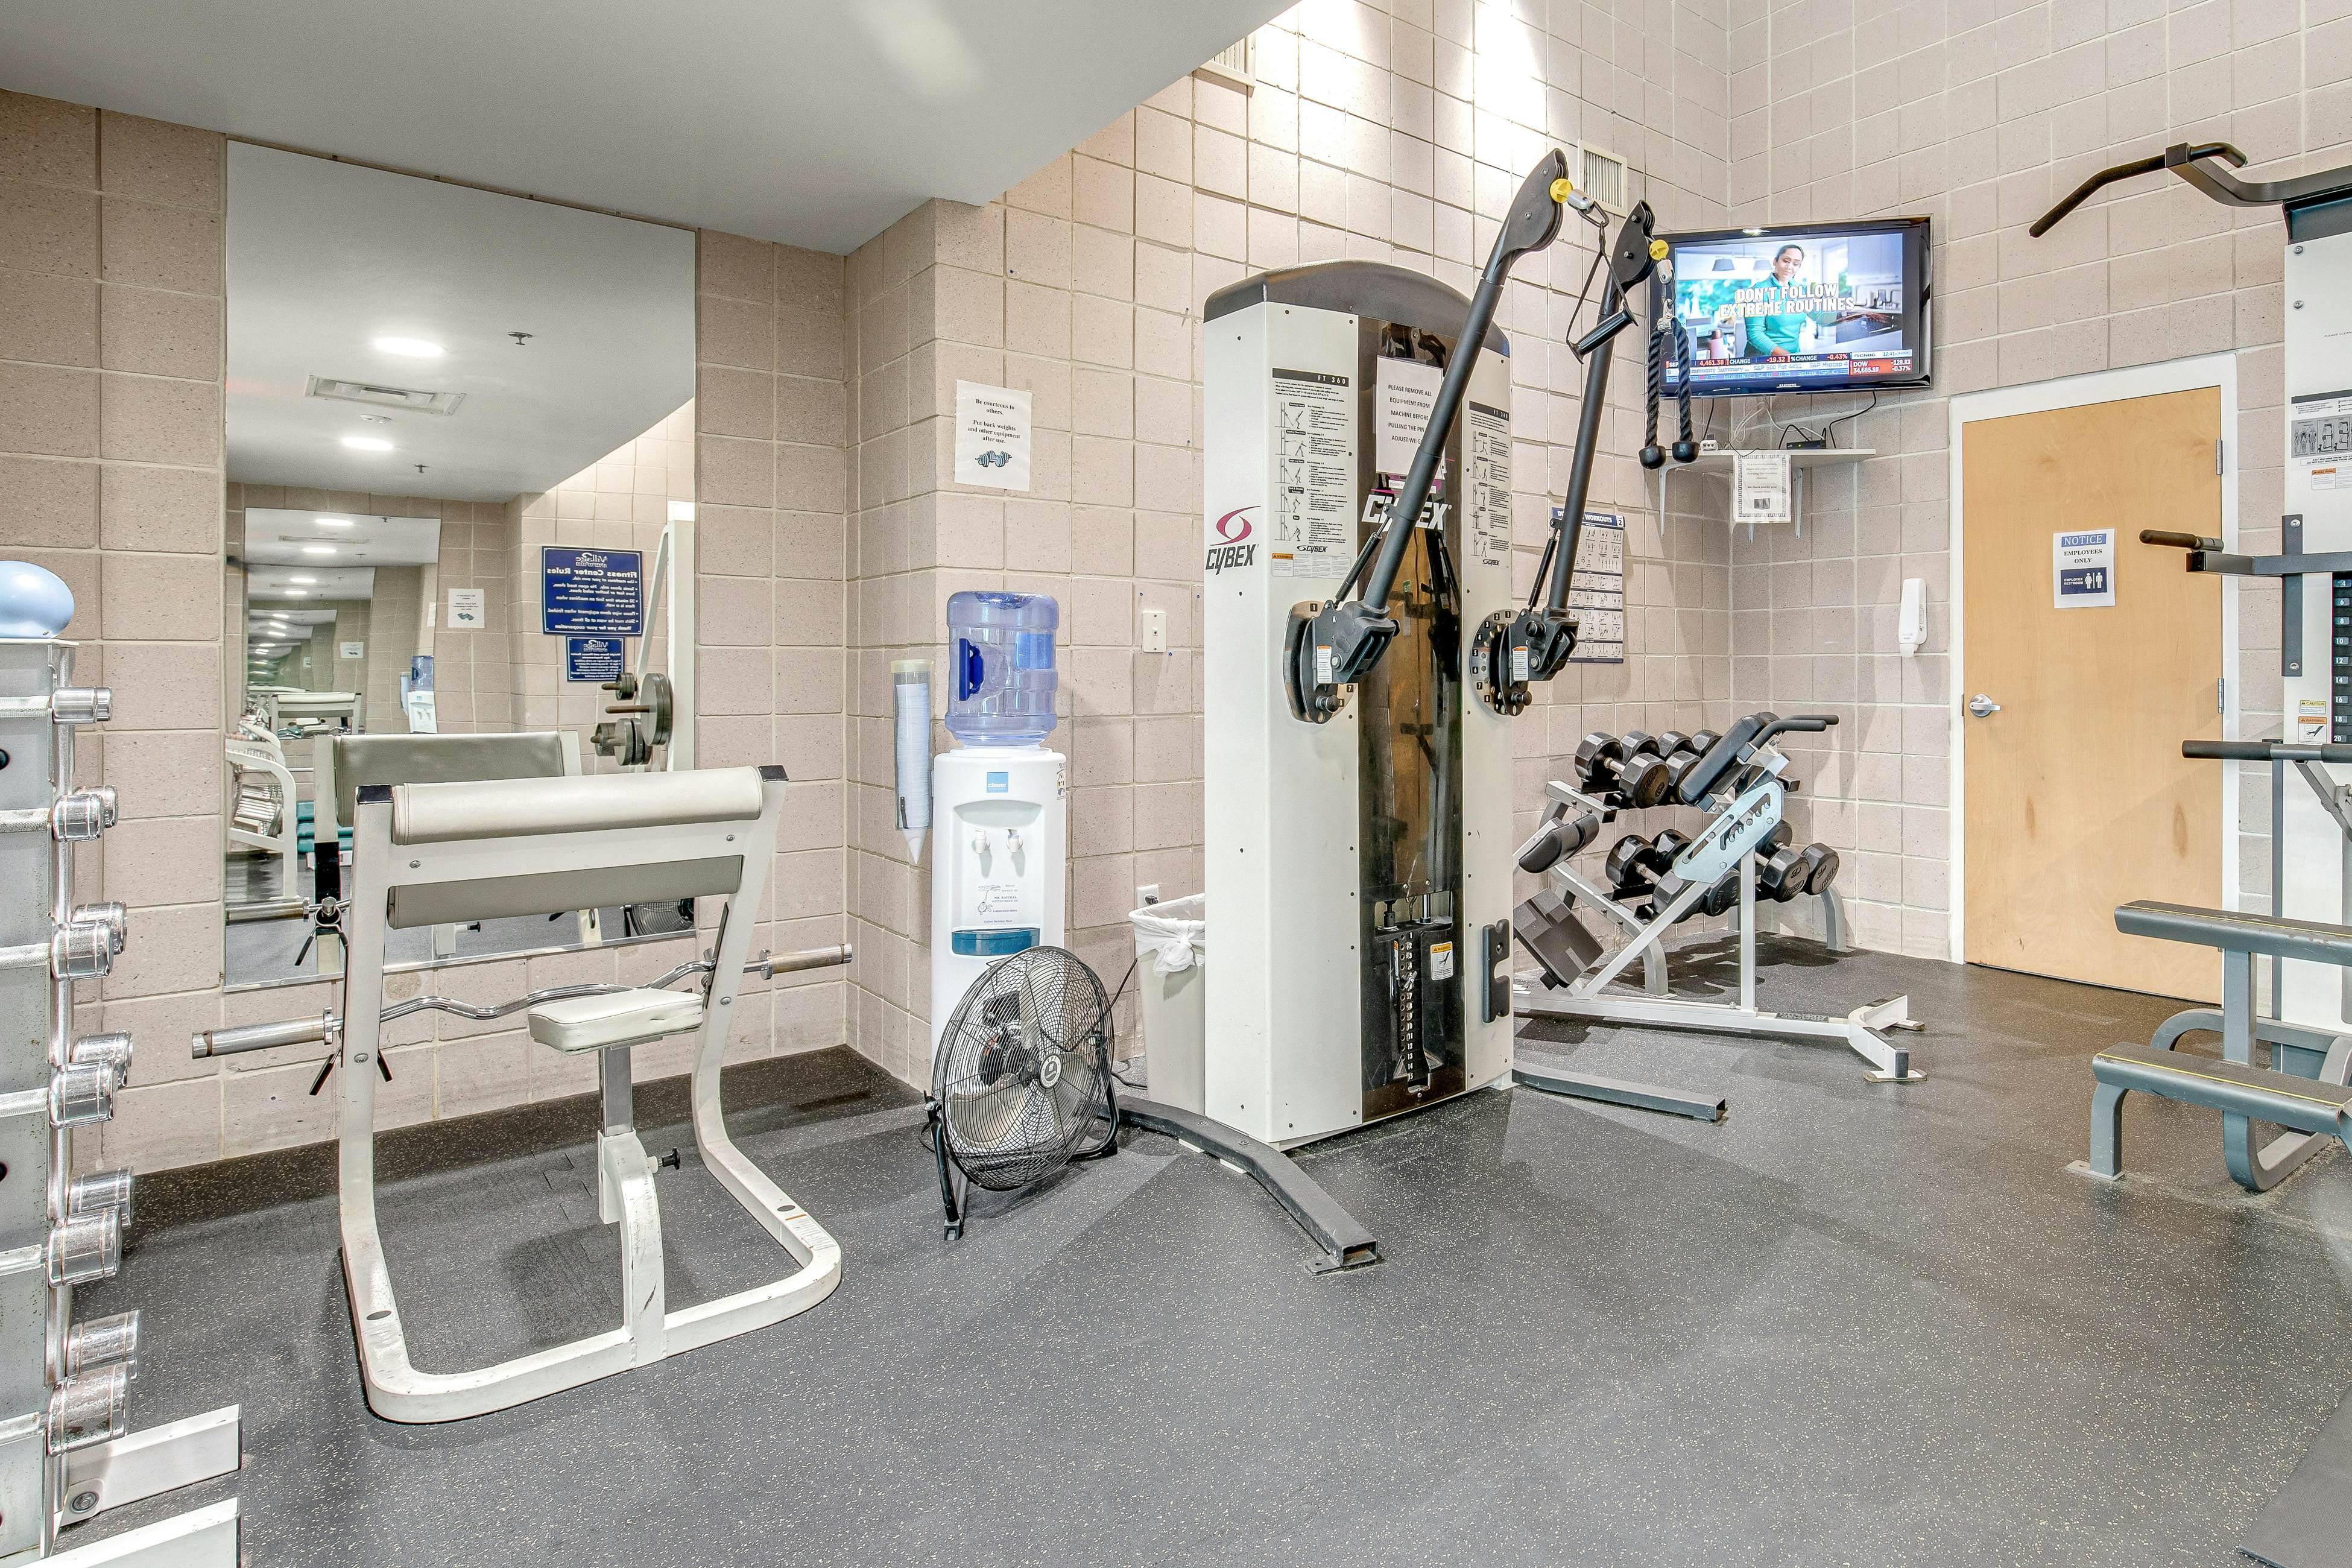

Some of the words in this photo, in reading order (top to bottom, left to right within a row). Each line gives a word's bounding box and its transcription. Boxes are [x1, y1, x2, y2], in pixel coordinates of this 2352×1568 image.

[1735, 287, 1777, 303] DON'T
[1781, 283, 1838, 299] FOLLOW
[1719, 302, 1782, 318] EXTREME
[1786, 297, 1855, 314] ROUTINES
[1405, 387, 1423, 395] REMOVE
[1389, 397, 1416, 406] EQUIPMENT
[1361, 495, 1448, 533] CYEX
[1585, 514, 1612, 523] WORKOUTS
[2064, 535, 2103, 546] NOTICE
[1206, 544, 1256, 575] CYBEX
